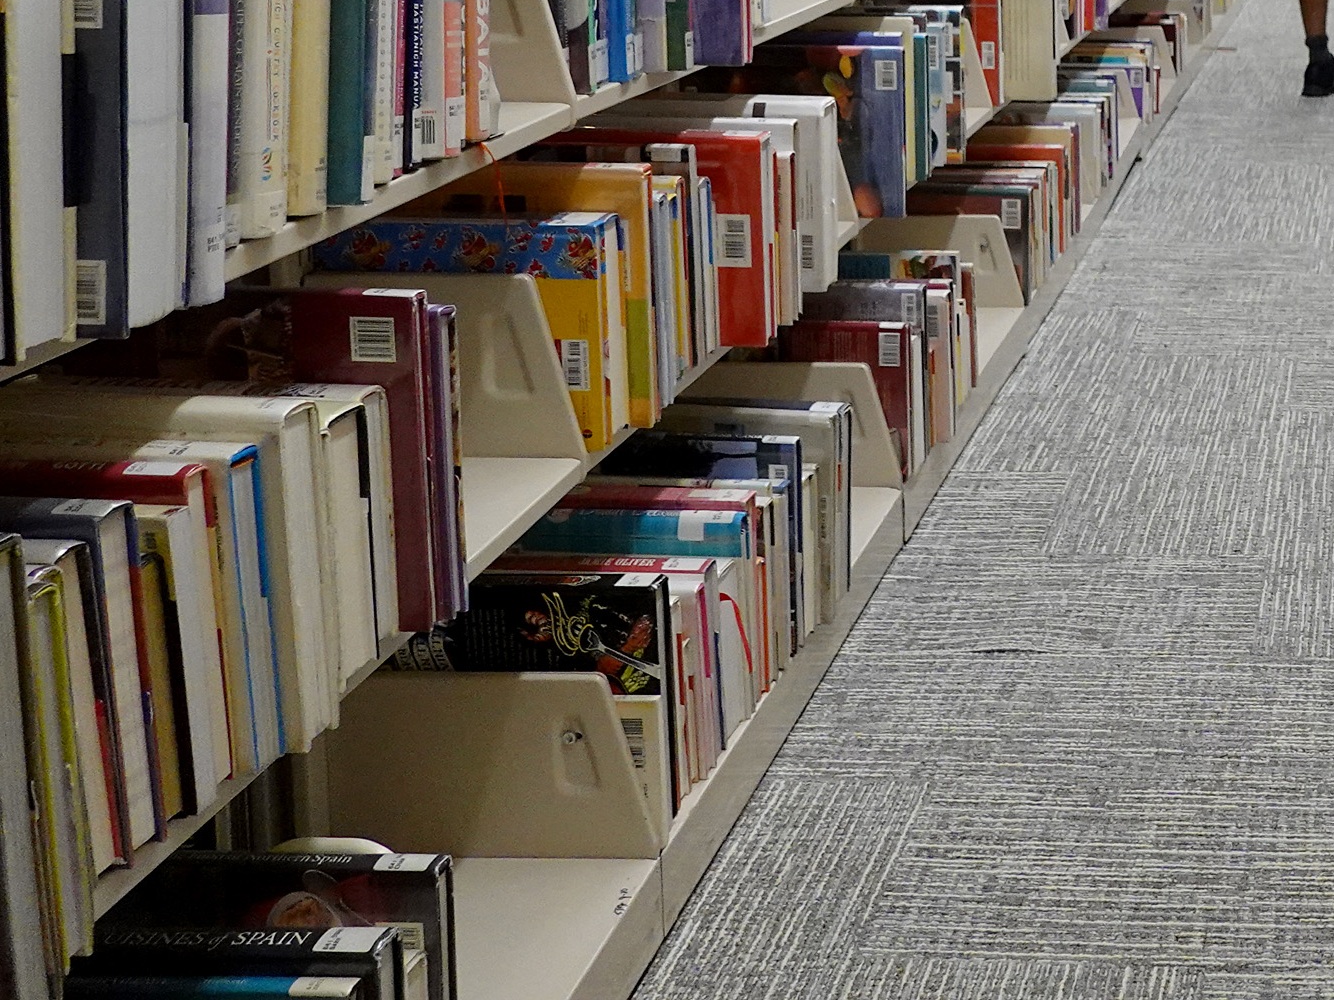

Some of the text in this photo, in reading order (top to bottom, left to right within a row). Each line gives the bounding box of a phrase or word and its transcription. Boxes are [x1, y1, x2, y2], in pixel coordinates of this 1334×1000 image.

[411, 1, 421, 68] BASTIANICH
[614, 557, 656, 567] OLIVER
[230, 931, 313, 946] SPAIN
